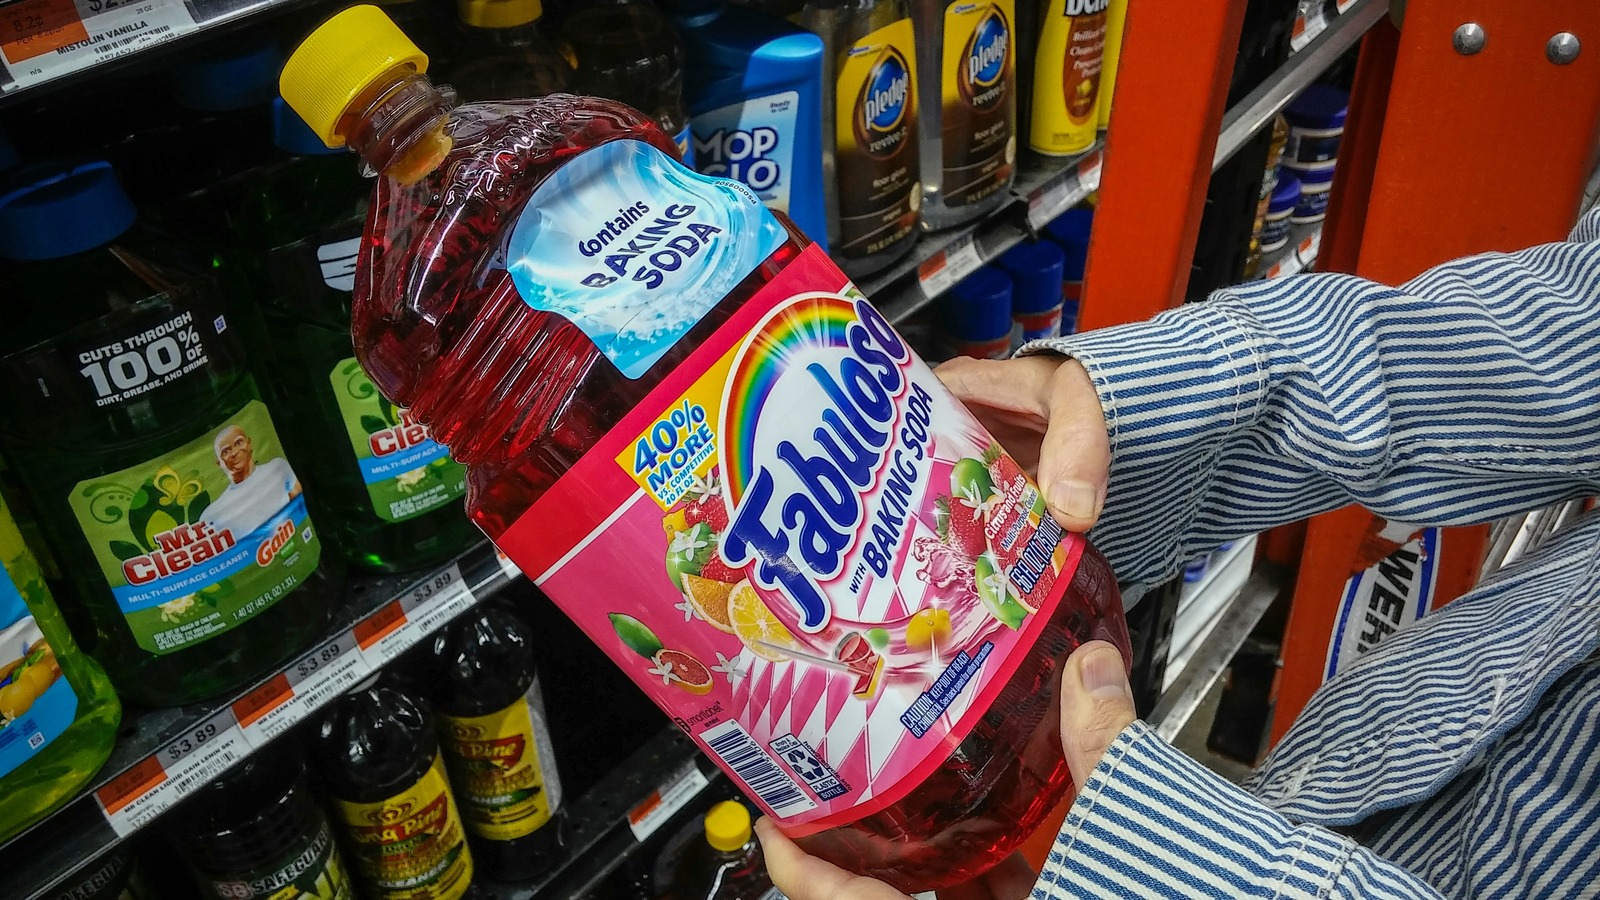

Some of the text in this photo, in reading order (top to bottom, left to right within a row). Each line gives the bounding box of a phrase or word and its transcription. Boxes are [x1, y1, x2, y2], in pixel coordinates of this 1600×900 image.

[56, 35, 105, 55] MISTOLIN
[106, 21, 148, 39] VANILLA
[969, 30, 1008, 84] pledge
[30, 68, 43, 76] n/a
[865, 72, 908, 130] pledge
[693, 128, 776, 163] MOP
[579, 200, 650, 257] Contains
[580, 204, 696, 288] BAKING
[632, 222, 722, 290] SODA
[79, 311, 193, 364] CUTS THROUGH
[80, 325, 203, 397] 100% OF
[96, 355, 209, 406] DIRT, GREASE, AND GRIME
[635, 399, 705, 474] 40%
[647, 423, 714, 493] MORE
[724, 299, 905, 627] Fabuloso
[658, 443, 715, 500] VS. COMPETITIVE
[666, 475, 695, 505] 40 FL OZ
[849, 381, 933, 595] WITH BAKING SODA
[984, 474, 1026, 540] Citrus and Fruits
[1002, 506, 1029, 549] Multi-Purpose
[123, 528, 237, 586] Clean
[154, 521, 215, 554] Mr.
[256, 519, 295, 567] Gain
[128, 571, 208, 604] MULTI-SURFACE
[208, 550, 249, 576] CLEANER
[1009, 567, 1033, 593] 56
[1015, 558, 1040, 581] FL
[232, 607, 247, 621] 1.40
[246, 601, 255, 615] QT
[264, 592, 274, 605] FL
[1357, 549, 1419, 654] WER
[296, 645, 341, 678] $3.89
[257, 716, 268, 725] MR
[267, 703, 289, 718] CLEAN
[288, 689, 311, 705] LEMON
[309, 676, 331, 691] LIQUID
[329, 658, 357, 677] CLEANER
[688, 701, 724, 726] smartlabel
[901, 693, 936, 729] CAUTION:
[929, 678, 944, 700] KEEP
[940, 669, 953, 691] OUT
[953, 651, 970, 672] REACH
[912, 726, 923, 738] OF
[918, 703, 944, 730] CHILDREN.
[940, 695, 950, 706] See
[947, 686, 958, 699] back
[954, 677, 966, 692] panel
[167, 723, 217, 760] $3.89
[803, 740, 852, 792] how2recycle.info
[124, 803, 136, 813] MR
[135, 788, 159, 805] CLEAN
[158, 772, 184, 791] LIQUID
[182, 761, 200, 775] GAIN
[200, 747, 221, 763] LENIN
[220, 738, 235, 750] SKY
[813, 778, 837, 792] PLASTIC
[821, 786, 843, 799] BOTTLE
